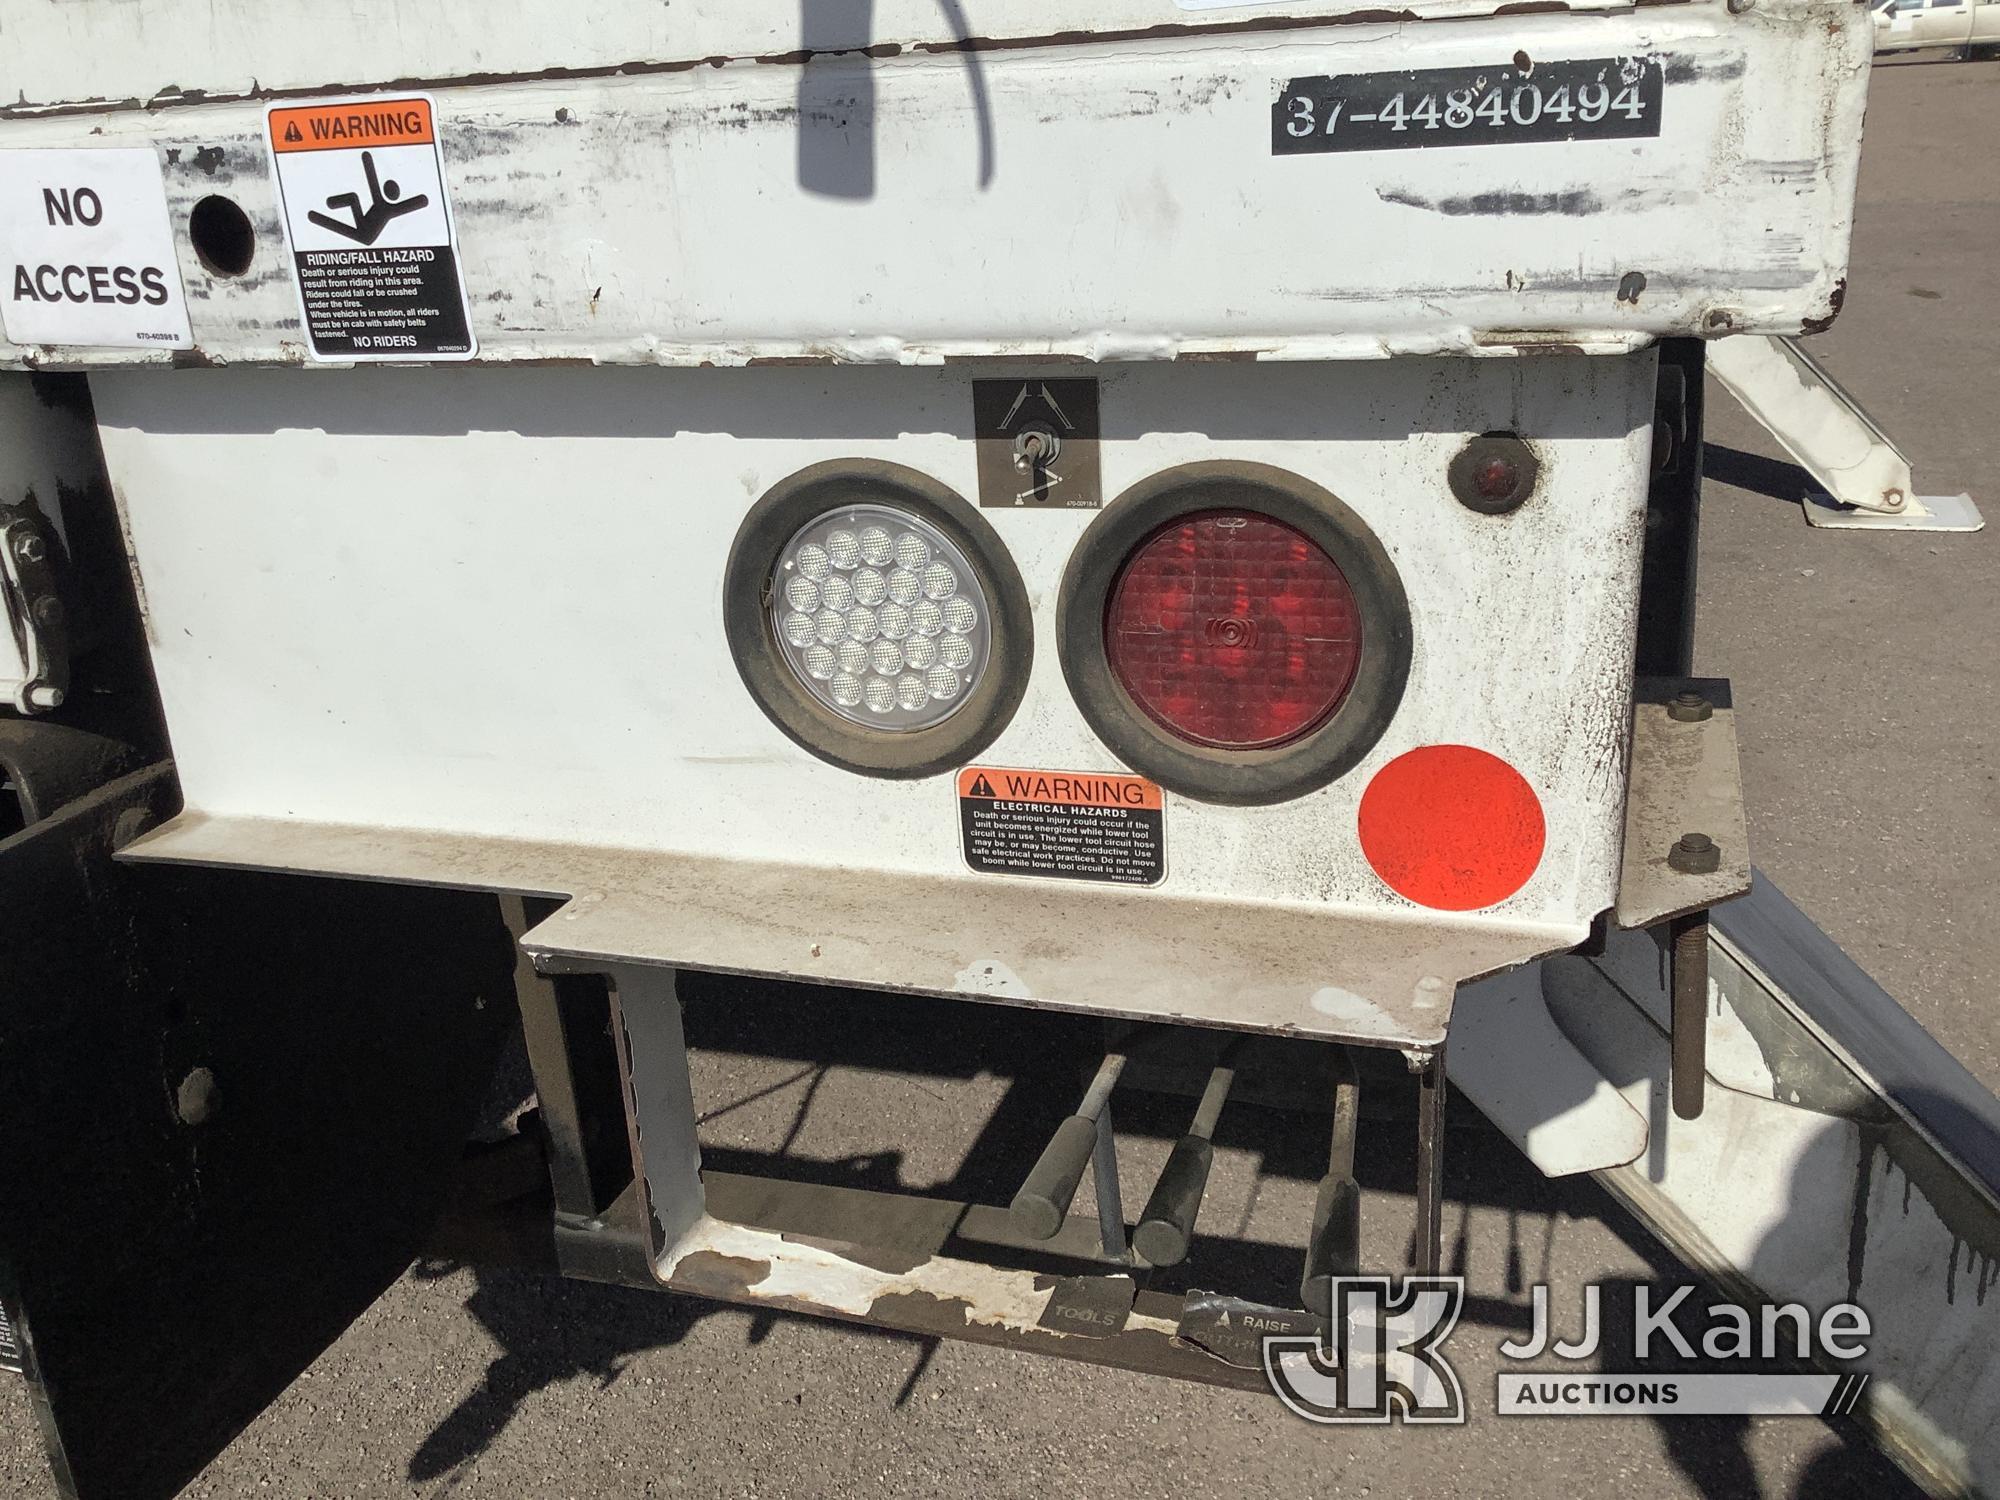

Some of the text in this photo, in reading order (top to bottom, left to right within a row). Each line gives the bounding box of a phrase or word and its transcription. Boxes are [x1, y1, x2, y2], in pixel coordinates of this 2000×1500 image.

[1287, 83, 1646, 137] 37-44840494
[309, 110, 423, 141] WARNING
[42, 187, 102, 227] NO
[307, 250, 434, 266] RIDING/FALL HAZARD
[302, 268, 325, 277] Death
[338, 266, 368, 276] serious
[370, 266, 394, 276] injury
[396, 265, 419, 274] could
[13, 265, 168, 306] ACCESS
[304, 276, 424, 288] result from riding in this area.
[306, 289, 329, 298] Riders
[331, 288, 351, 297] could
[353, 288, 364, 297] fall
[376, 288, 385, 296] be
[387, 288, 417, 296] crushed
[331, 300, 342, 308] the
[311, 310, 331, 318] When
[332, 310, 358, 318] vehicle
[369, 309, 376, 317] in
[378, 309, 405, 317] motion,
[417, 308, 439, 316] riders
[332, 320, 341, 328] be
[342, 320, 349, 328] in
[351, 320, 364, 328] cab
[366, 319, 382, 327] with
[383, 319, 406, 328] safety
[408, 319, 426, 327] belts
[315, 330, 348, 338] fastened.
[354, 336, 417, 348] NO RIDERS
[1007, 776, 1144, 804] WARNING
[994, 802, 1128, 818] ELECTRICAL HAZARDS
[974, 811, 998, 820] Death
[1013, 813, 1044, 823] serious
[1047, 815, 1070, 825] injury
[1074, 817, 1097, 826] could
[1100, 819, 1124, 828] occur
[1127, 820, 1133, 828] if
[1136, 820, 1149, 829] the
[994, 821, 1032, 831] becomes
[1035, 824, 1077, 834] energized
[1080, 827, 1102, 836] while
[1105, 829, 1130, 838] lower
[1133, 830, 1149, 839] tool
[975, 840, 991, 848] may
[1023, 843, 1039, 851] may
[1135, 850, 1151, 858] Use
[1019, 833, 1037, 841] use.
[1040, 834, 1056, 842] The
[1059, 835, 1083, 844] lower
[1086, 837, 1102, 845] tool
[1105, 838, 1131, 847] circuit
[1134, 840, 1155, 849] hose
[972, 847, 989, 855] safe
[992, 848, 1030, 858] electrical
[1033, 851, 1053, 860] work
[1056, 854, 1097, 864] practices.
[1101, 856, 1113, 864] Do
[1117, 857, 1129, 865] not
[983, 857, 1004, 865] boom
[1008, 858, 1029, 867] while
[1032, 860, 1055, 869] lower
[1058, 862, 1074, 870] tool
[1077, 864, 1103, 872] circuit
[1055, 1305, 1116, 1326] TOOLS
[1243, 1316, 1291, 1333] RAISE
